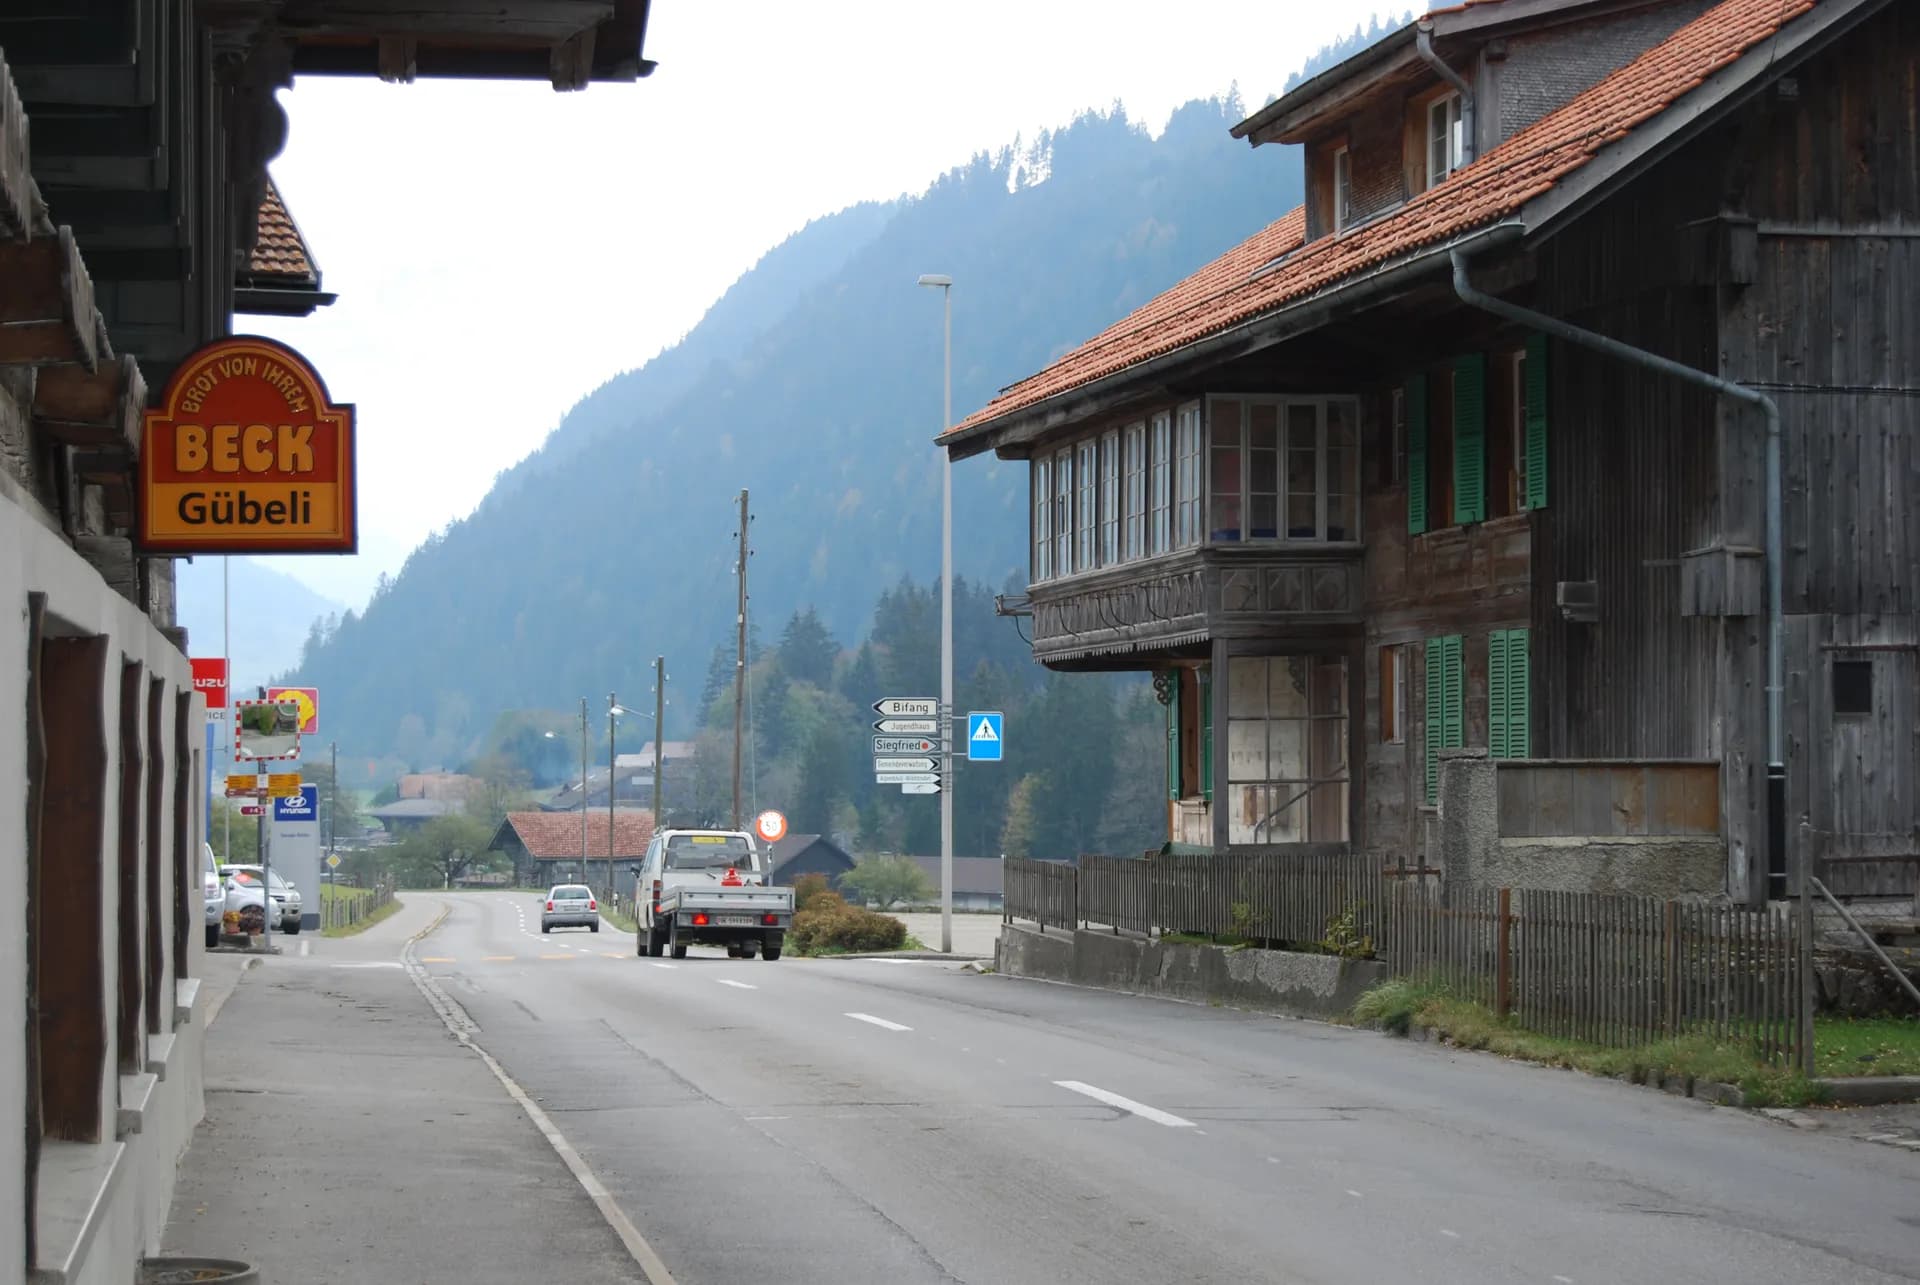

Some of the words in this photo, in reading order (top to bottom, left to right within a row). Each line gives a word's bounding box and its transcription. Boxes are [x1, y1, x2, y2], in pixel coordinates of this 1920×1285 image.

[181, 367, 218, 414] BROT
[218, 357, 257, 378] VON
[261, 361, 310, 414] IHREM
[175, 424, 314, 473] BECK
[178, 490, 311, 525] Gübeli
[191, 678, 226, 688] UZU
[893, 702, 929, 714] Bifang
[876, 739, 921, 752] Siegfried
